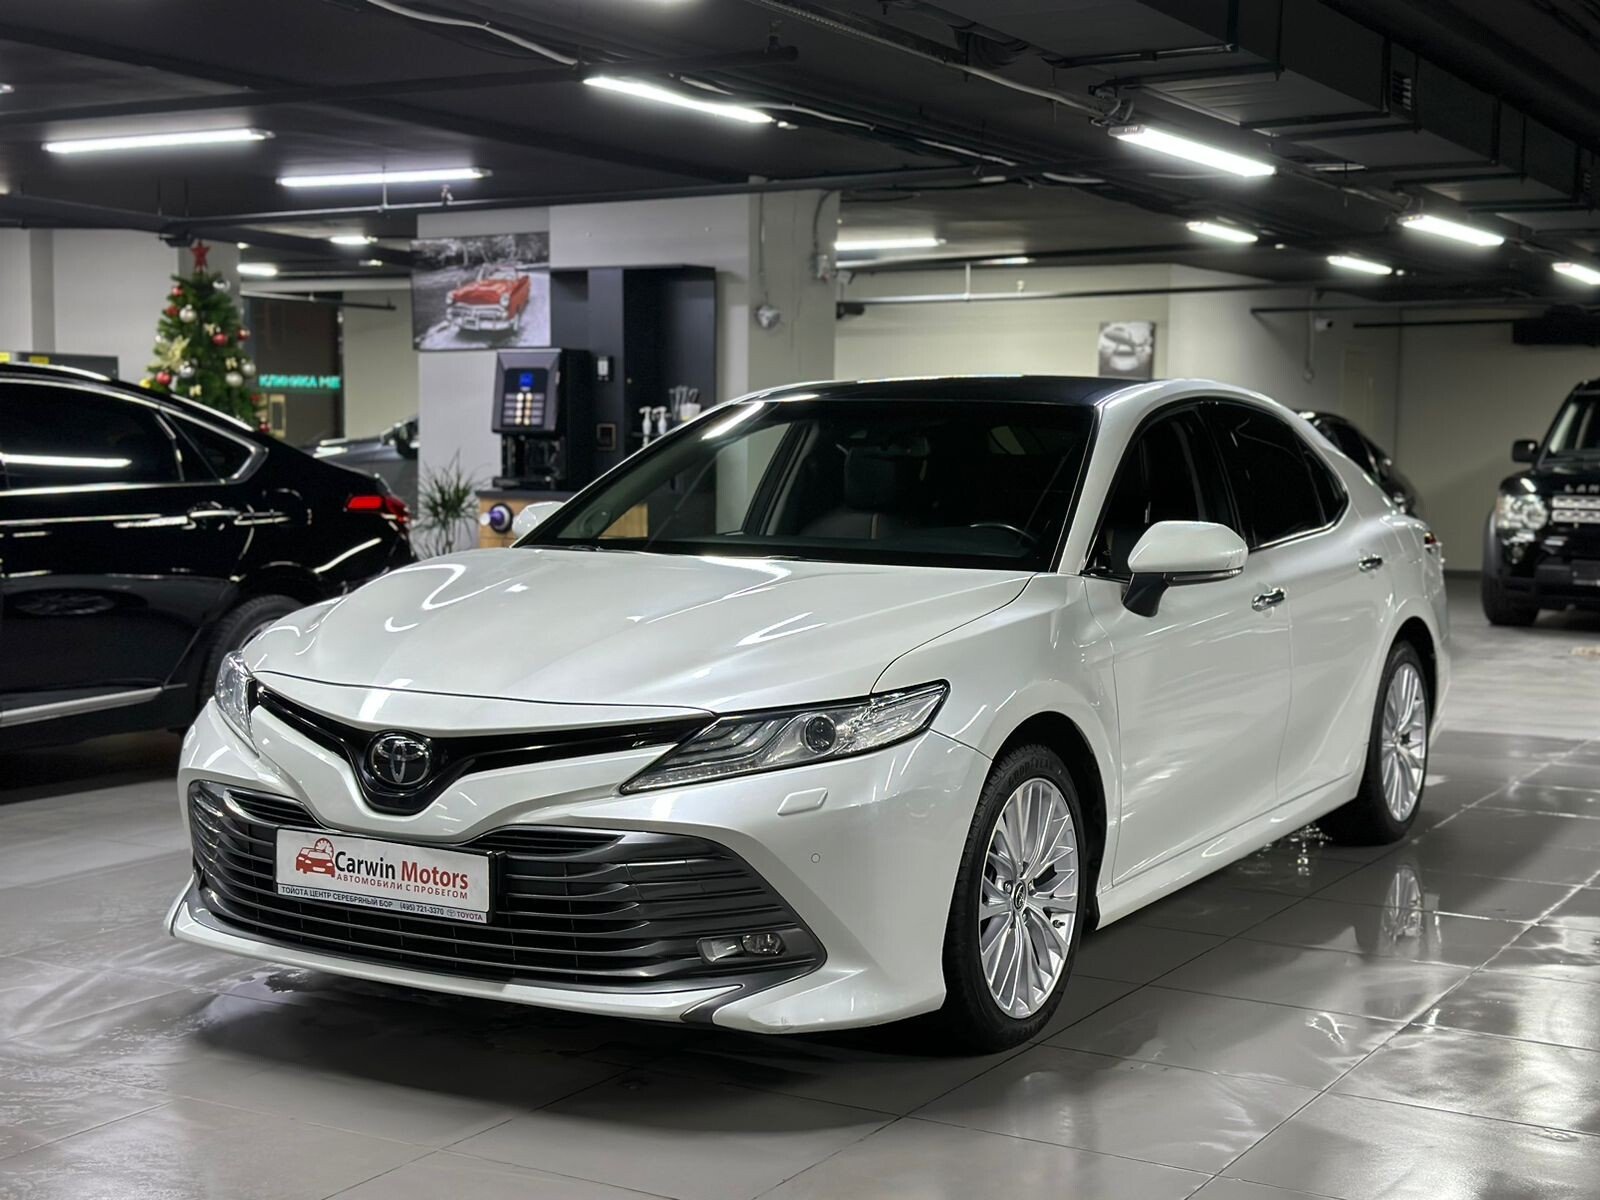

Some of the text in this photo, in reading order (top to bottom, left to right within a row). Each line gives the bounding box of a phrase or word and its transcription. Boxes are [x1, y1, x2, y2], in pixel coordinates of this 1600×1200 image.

[335, 851, 469, 890] Carwin Motors
[281, 886, 309, 897] ТОЙОТА
[309, 890, 331, 899] ЦЕНТР
[332, 893, 378, 906] СЕРЕБРЯНЫЙ
[379, 899, 393, 908] БОР
[337, 873, 403, 891] АВТОМОБИЛИ
[413, 884, 468, 900] ПРОБЕГОМ
[457, 911, 483, 921] TOYOTA
